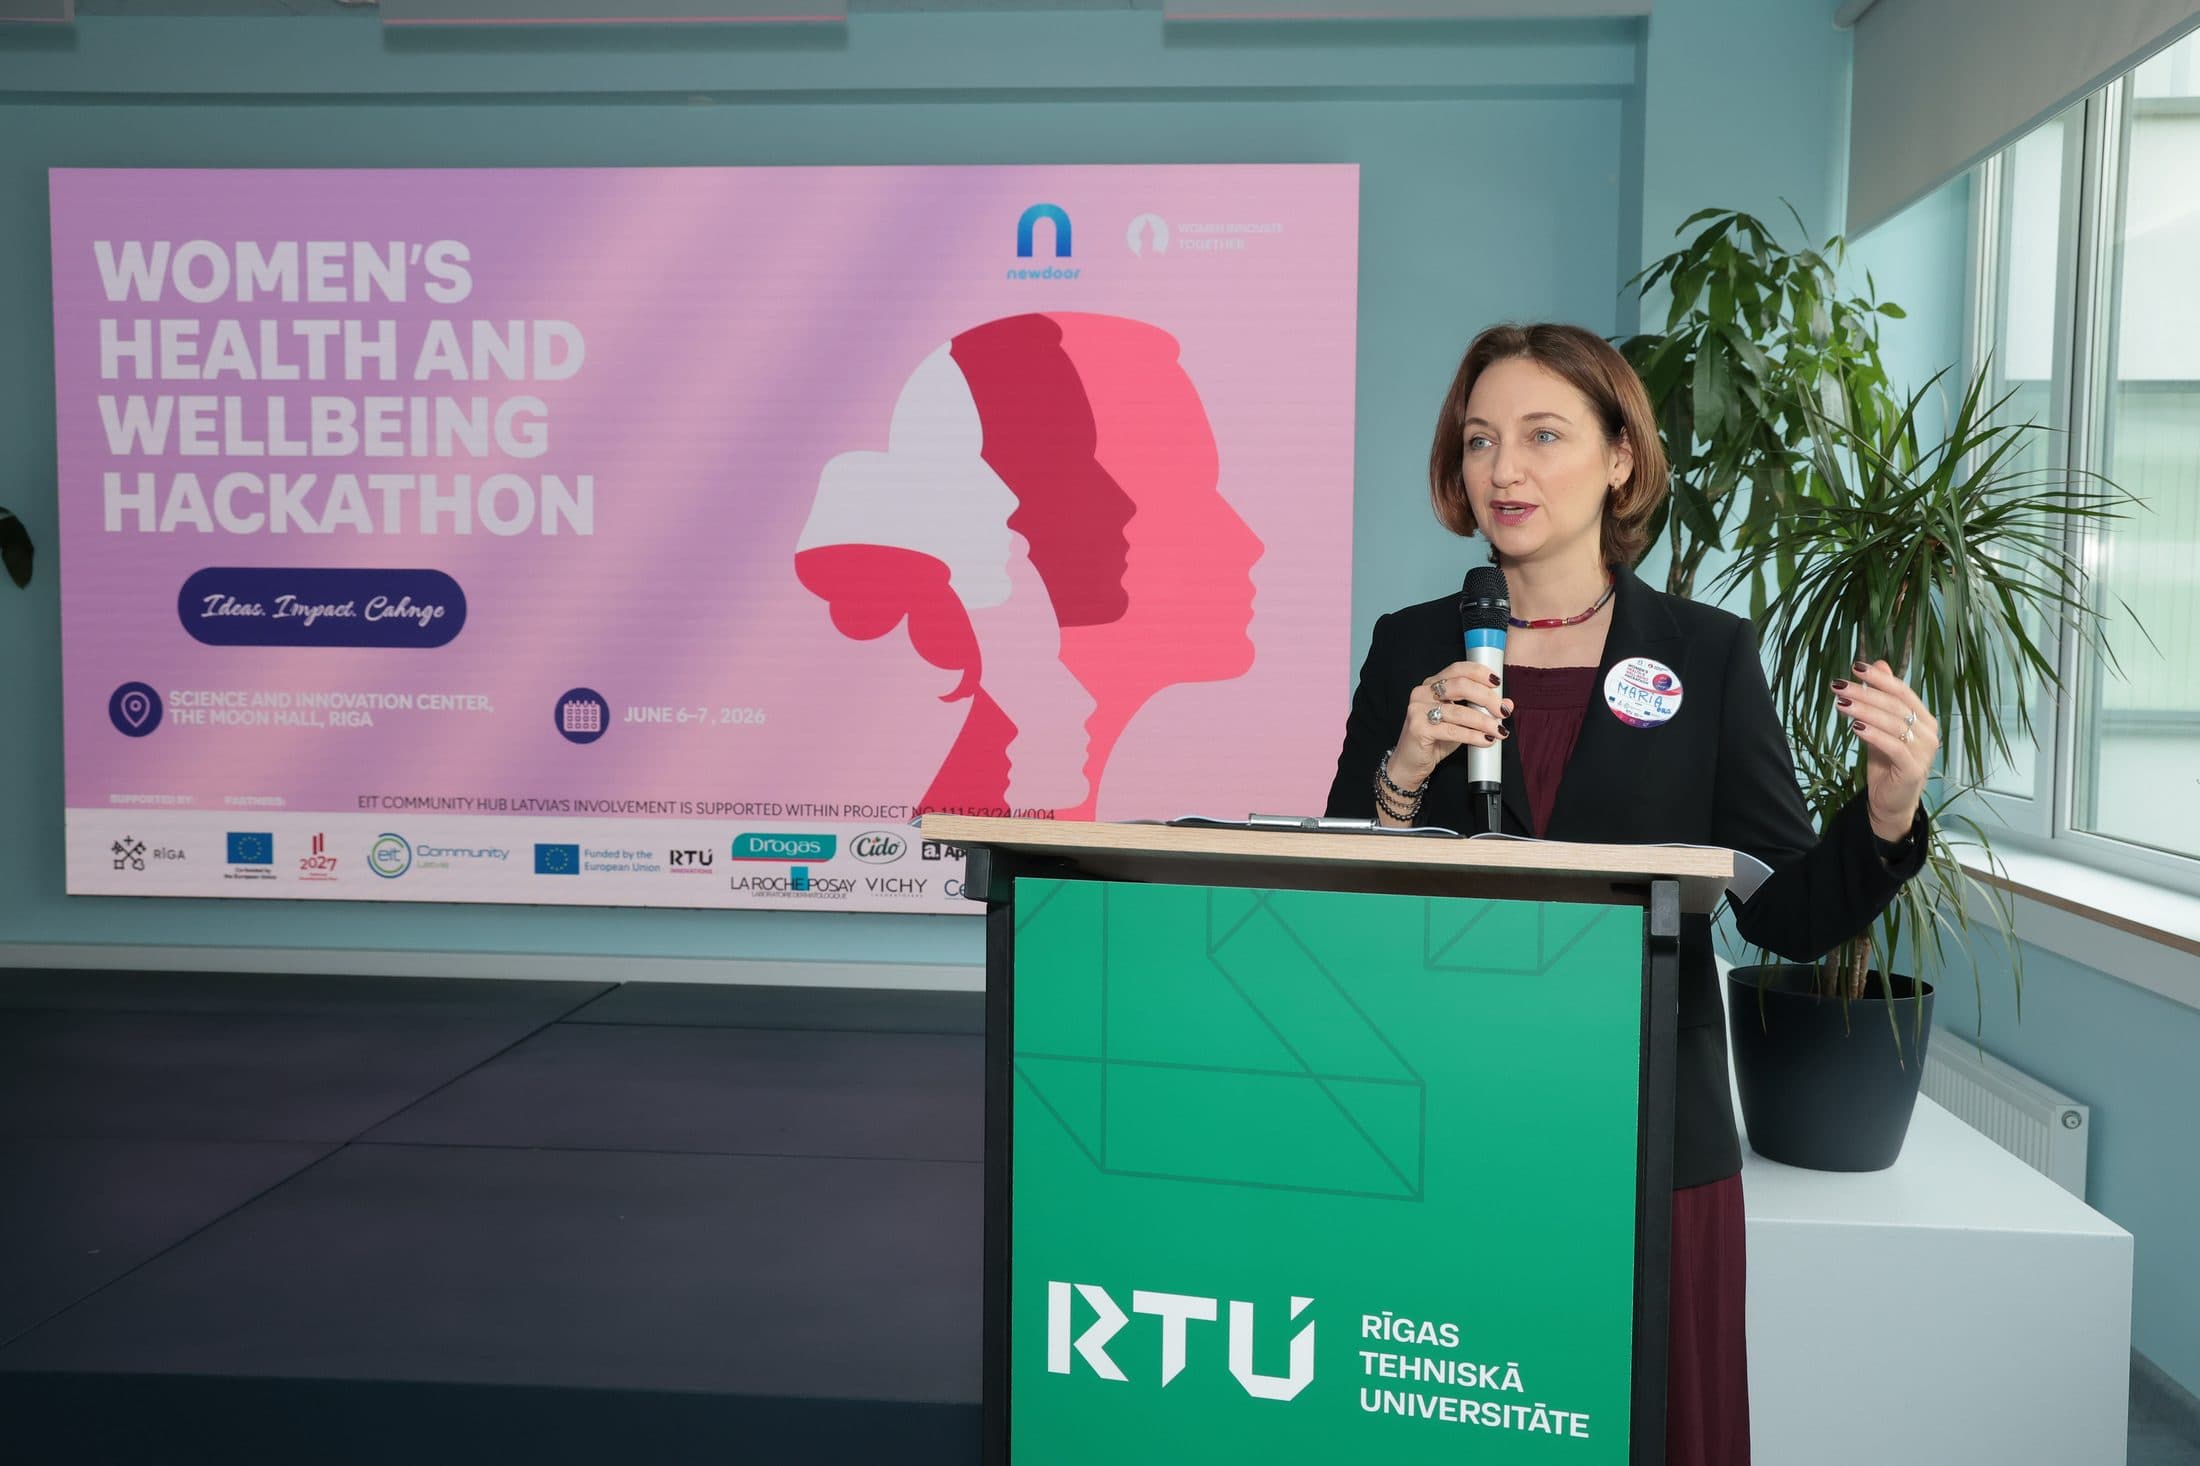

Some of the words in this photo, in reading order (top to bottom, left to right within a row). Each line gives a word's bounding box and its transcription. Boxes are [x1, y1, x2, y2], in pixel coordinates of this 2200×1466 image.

[94, 239, 473, 303] WOMEN’S
[1007, 266, 1081, 280] newdoor
[100, 319, 397, 380] HEALTH
[413, 319, 586, 381] AND
[98, 395, 549, 458] WELLBEING
[103, 471, 594, 536] HACKATHON
[201, 594, 266, 618] Ideas.
[272, 594, 357, 626] Impact.
[365, 595, 445, 627] Cahnge
[169, 691, 248, 707] SCIENCE
[251, 692, 293, 708] AND
[296, 692, 412, 709] INNOVATION
[416, 694, 494, 712] CENTER,
[169, 708, 205, 725] THE
[209, 709, 269, 726] MOON
[273, 710, 325, 728] HALL,
[329, 711, 373, 727] RIGA
[623, 706, 672, 723] JUNE
[720, 708, 766, 725] 2026
[358, 795, 378, 808] EIT
[382, 796, 475, 810] COMMUNITY
[477, 798, 508, 811] HUB
[511, 799, 570, 812] LATVIA'S
[574, 800, 677, 814] INVOLVEMENT
[680, 801, 692, 815] IS
[697, 802, 782, 816] SUPPORTED
[785, 803, 840, 817] WITHIN
[844, 804, 908, 819] PROJECT
[377, 847, 401, 862] eit
[416, 845, 510, 861] Community
[584, 849, 620, 859] Funded
[622, 849, 634, 860] by
[636, 850, 653, 859] the
[750, 837, 821, 855] Drogas
[857, 836, 899, 855] Cido
[300, 856, 337, 873] 2027
[584, 862, 630, 872] European
[632, 863, 661, 872] Union
[730, 877, 750, 890] LA
[865, 877, 928, 893] VICHY
[1360, 1311, 1460, 1348] RĪGAS
[1359, 1350, 1524, 1393] TEHNISKĀ
[1359, 1387, 1590, 1438] UNIVERSITĀTE
